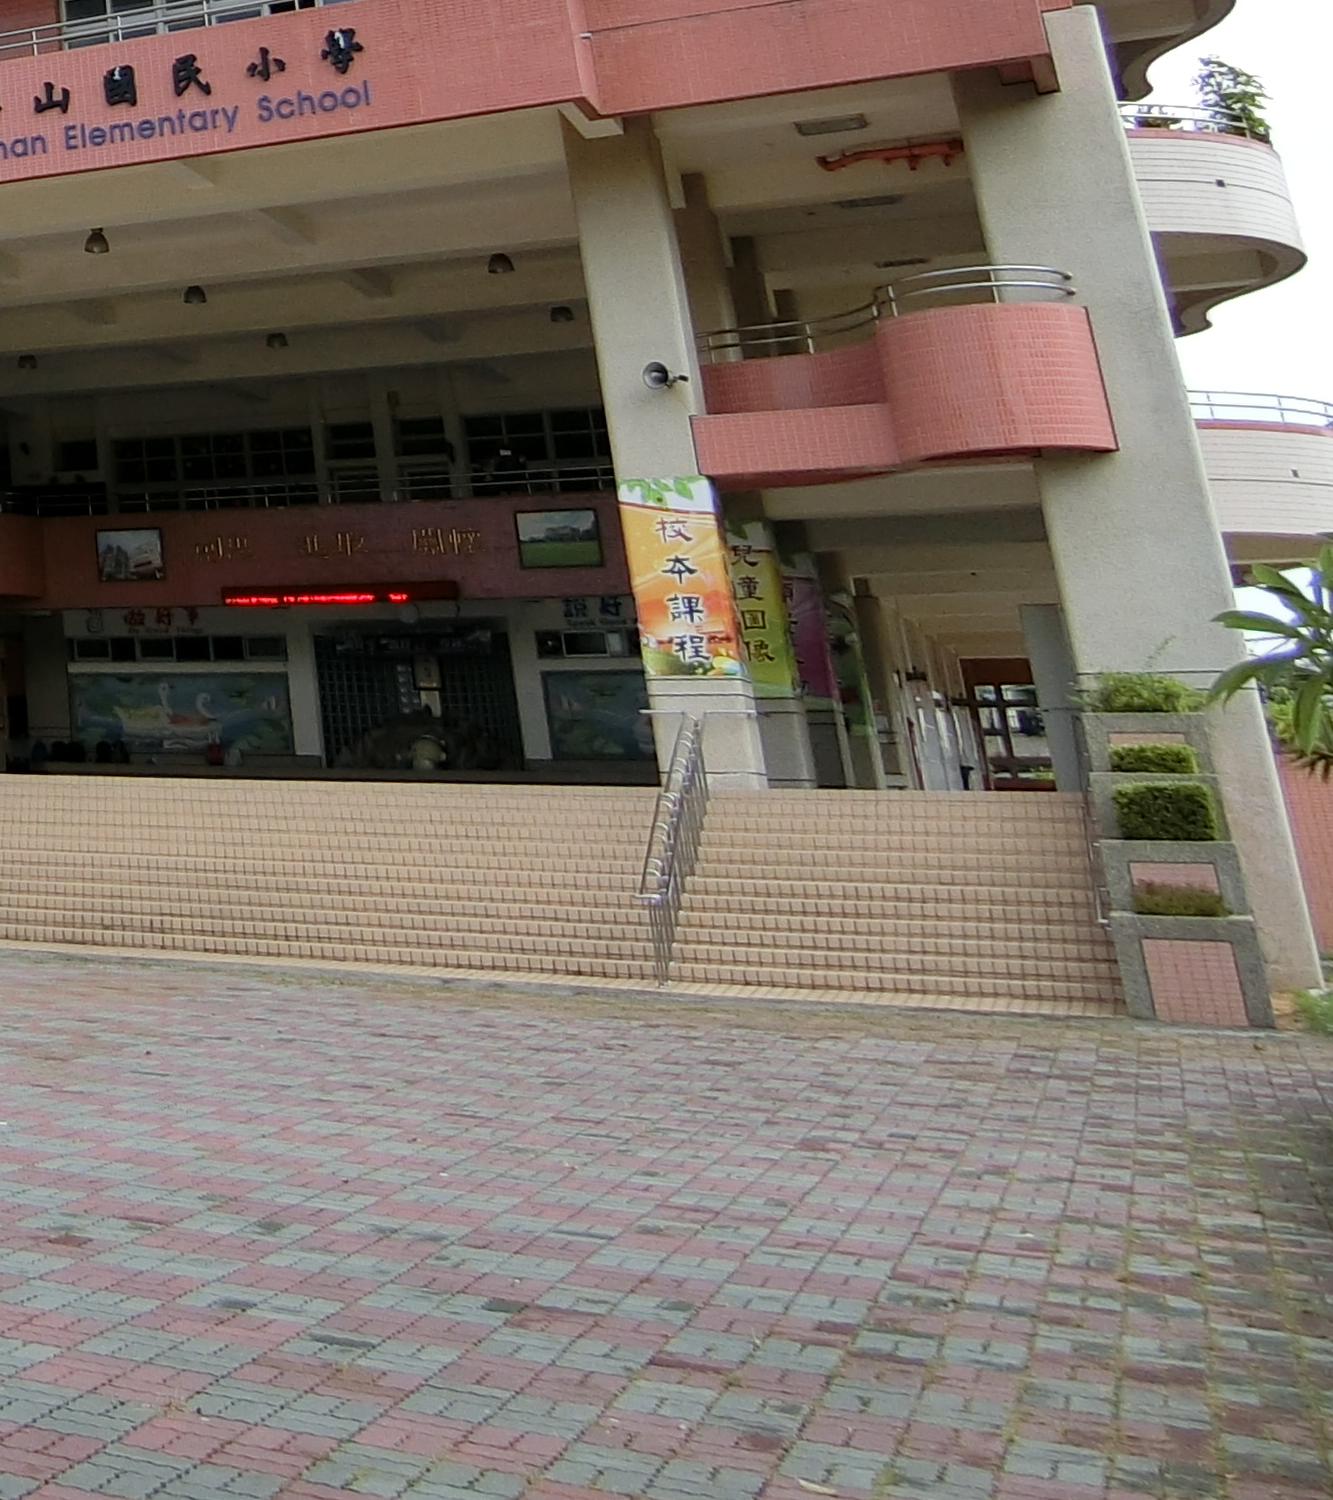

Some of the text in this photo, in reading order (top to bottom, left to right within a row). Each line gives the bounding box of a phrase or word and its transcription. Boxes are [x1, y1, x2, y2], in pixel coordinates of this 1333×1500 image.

[63, 104, 237, 150] Elementary
[255, 79, 369, 122] School
[654, 517, 711, 662] 校本課程
